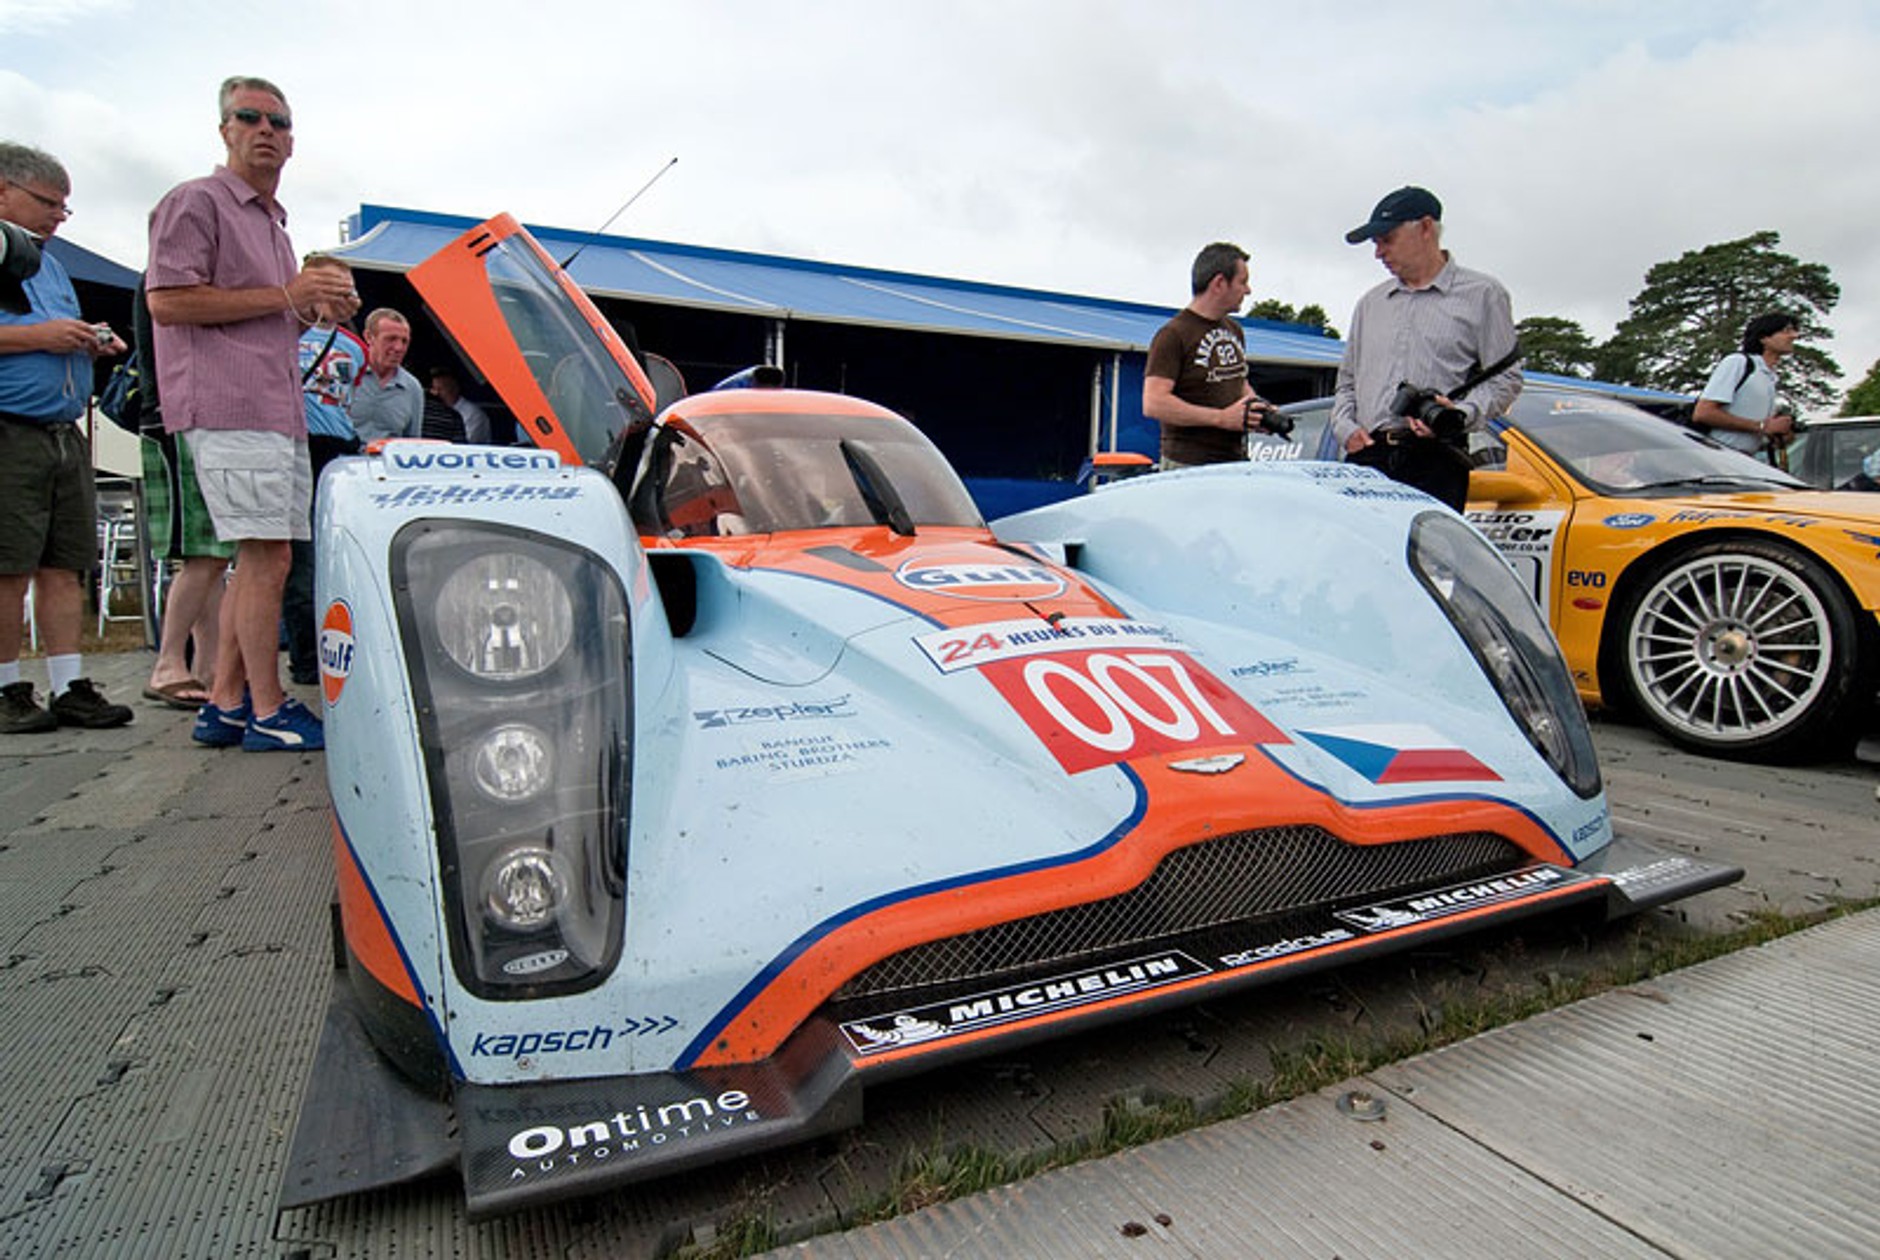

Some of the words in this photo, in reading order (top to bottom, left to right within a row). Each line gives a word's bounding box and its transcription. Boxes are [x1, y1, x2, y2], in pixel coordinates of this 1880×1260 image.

[393, 452, 556, 469] worten
[904, 568, 1055, 585] Gulf
[1568, 570, 1606, 588] evo
[321, 635, 352, 671] Gulf
[938, 633, 1004, 664] 24
[1007, 625, 1086, 646] HEURES
[1086, 624, 1117, 636] DU
[1023, 653, 1237, 752] 007
[1409, 869, 1562, 912] MICHELIN
[950, 957, 1180, 1022] MICHELIN
[470, 1025, 613, 1060] kapsch
[508, 1090, 749, 1158] Ontime
[511, 1110, 760, 1179] AUTOMOTIVE
